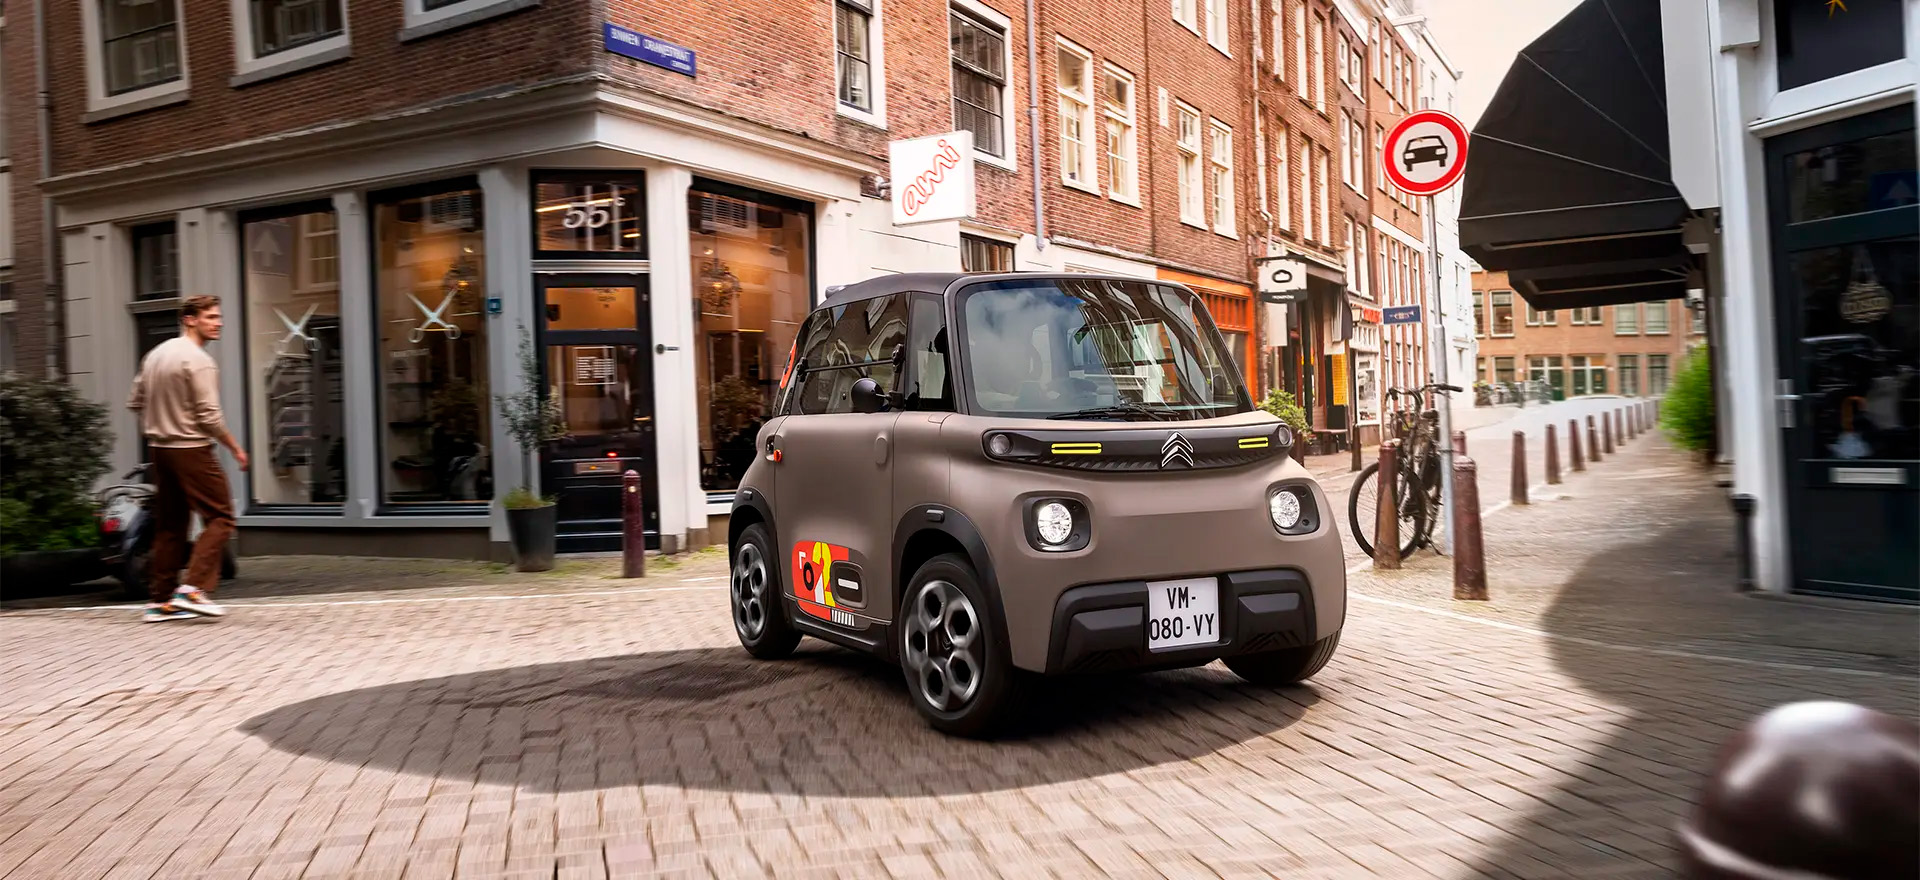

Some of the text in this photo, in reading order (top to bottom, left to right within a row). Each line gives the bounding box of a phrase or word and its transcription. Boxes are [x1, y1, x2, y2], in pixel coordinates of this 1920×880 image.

[902, 139, 961, 216] ami
[1166, 586, 1197, 610] VM-
[1149, 613, 1215, 641] 080-VY
